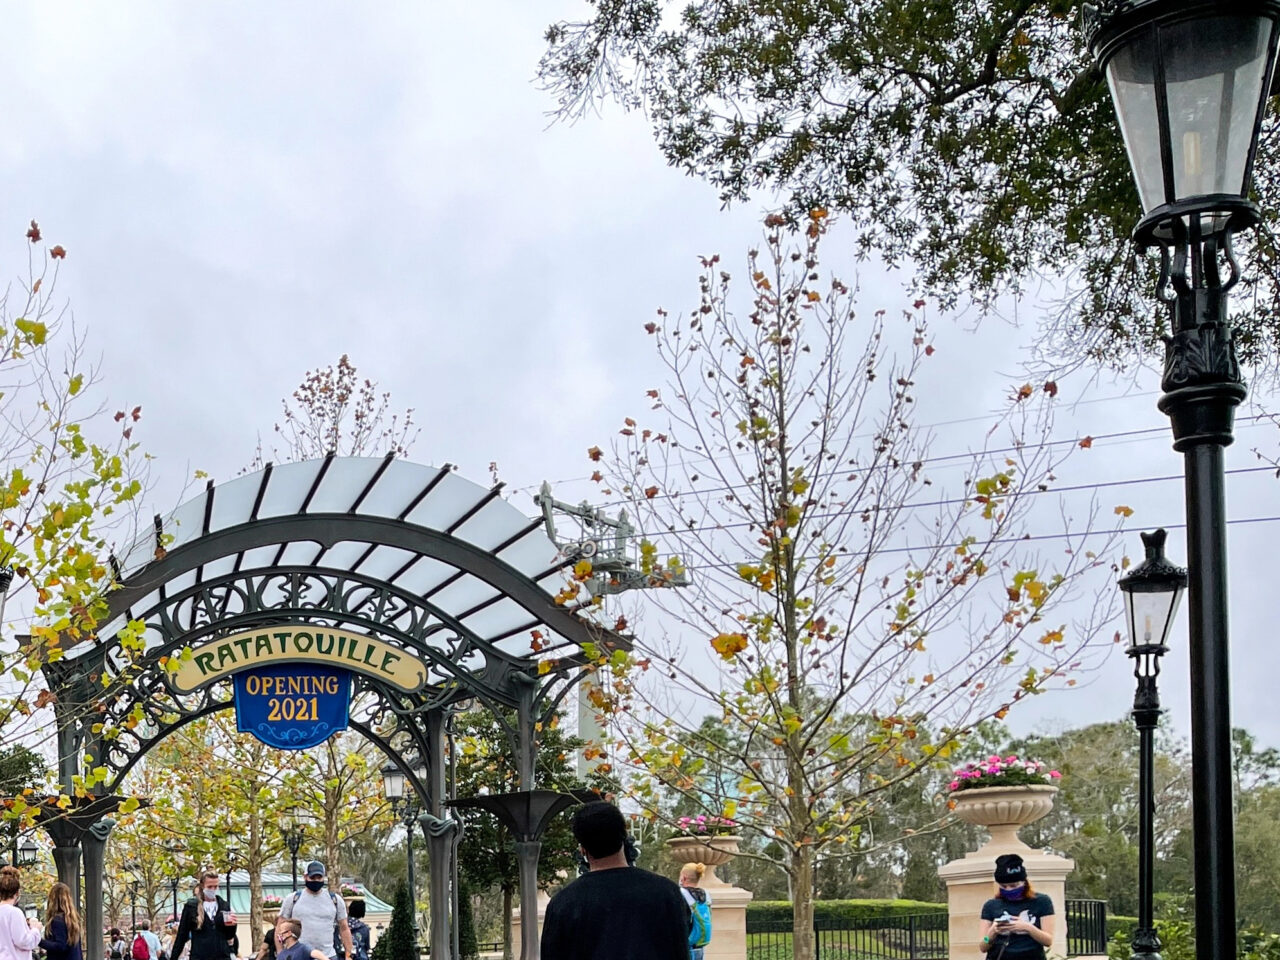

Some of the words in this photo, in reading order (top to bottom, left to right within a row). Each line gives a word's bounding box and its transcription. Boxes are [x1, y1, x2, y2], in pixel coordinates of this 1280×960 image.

[194, 632, 401, 676] RATATOUILLE
[246, 675, 339, 695] OPENING
[268, 697, 319, 721] 2021
